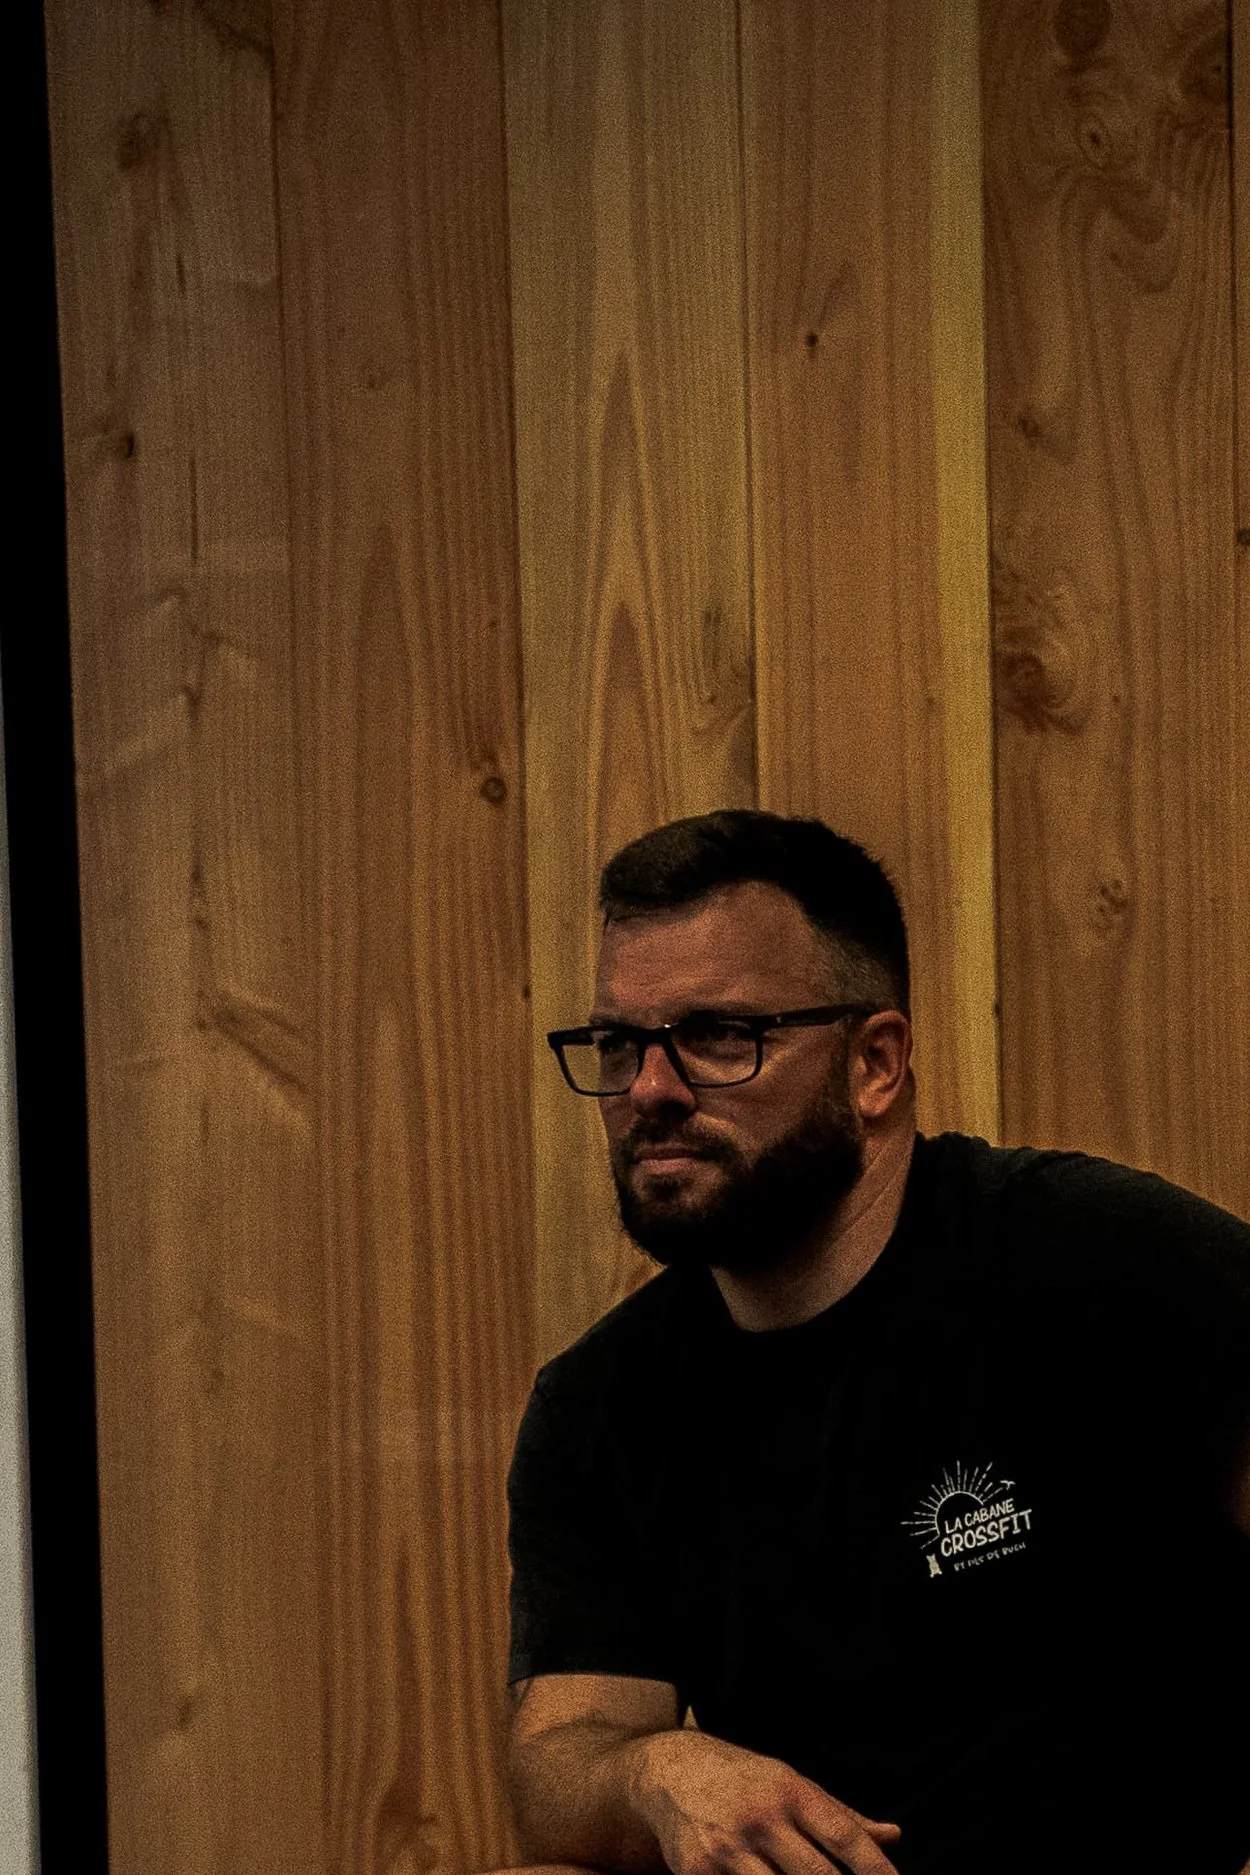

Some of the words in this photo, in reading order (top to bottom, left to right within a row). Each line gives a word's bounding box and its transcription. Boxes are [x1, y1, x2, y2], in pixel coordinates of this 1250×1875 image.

[940, 1508, 1033, 1557] CROSSFIT
[944, 1516, 963, 1535] LA
[964, 1497, 1015, 1527] CABANE
